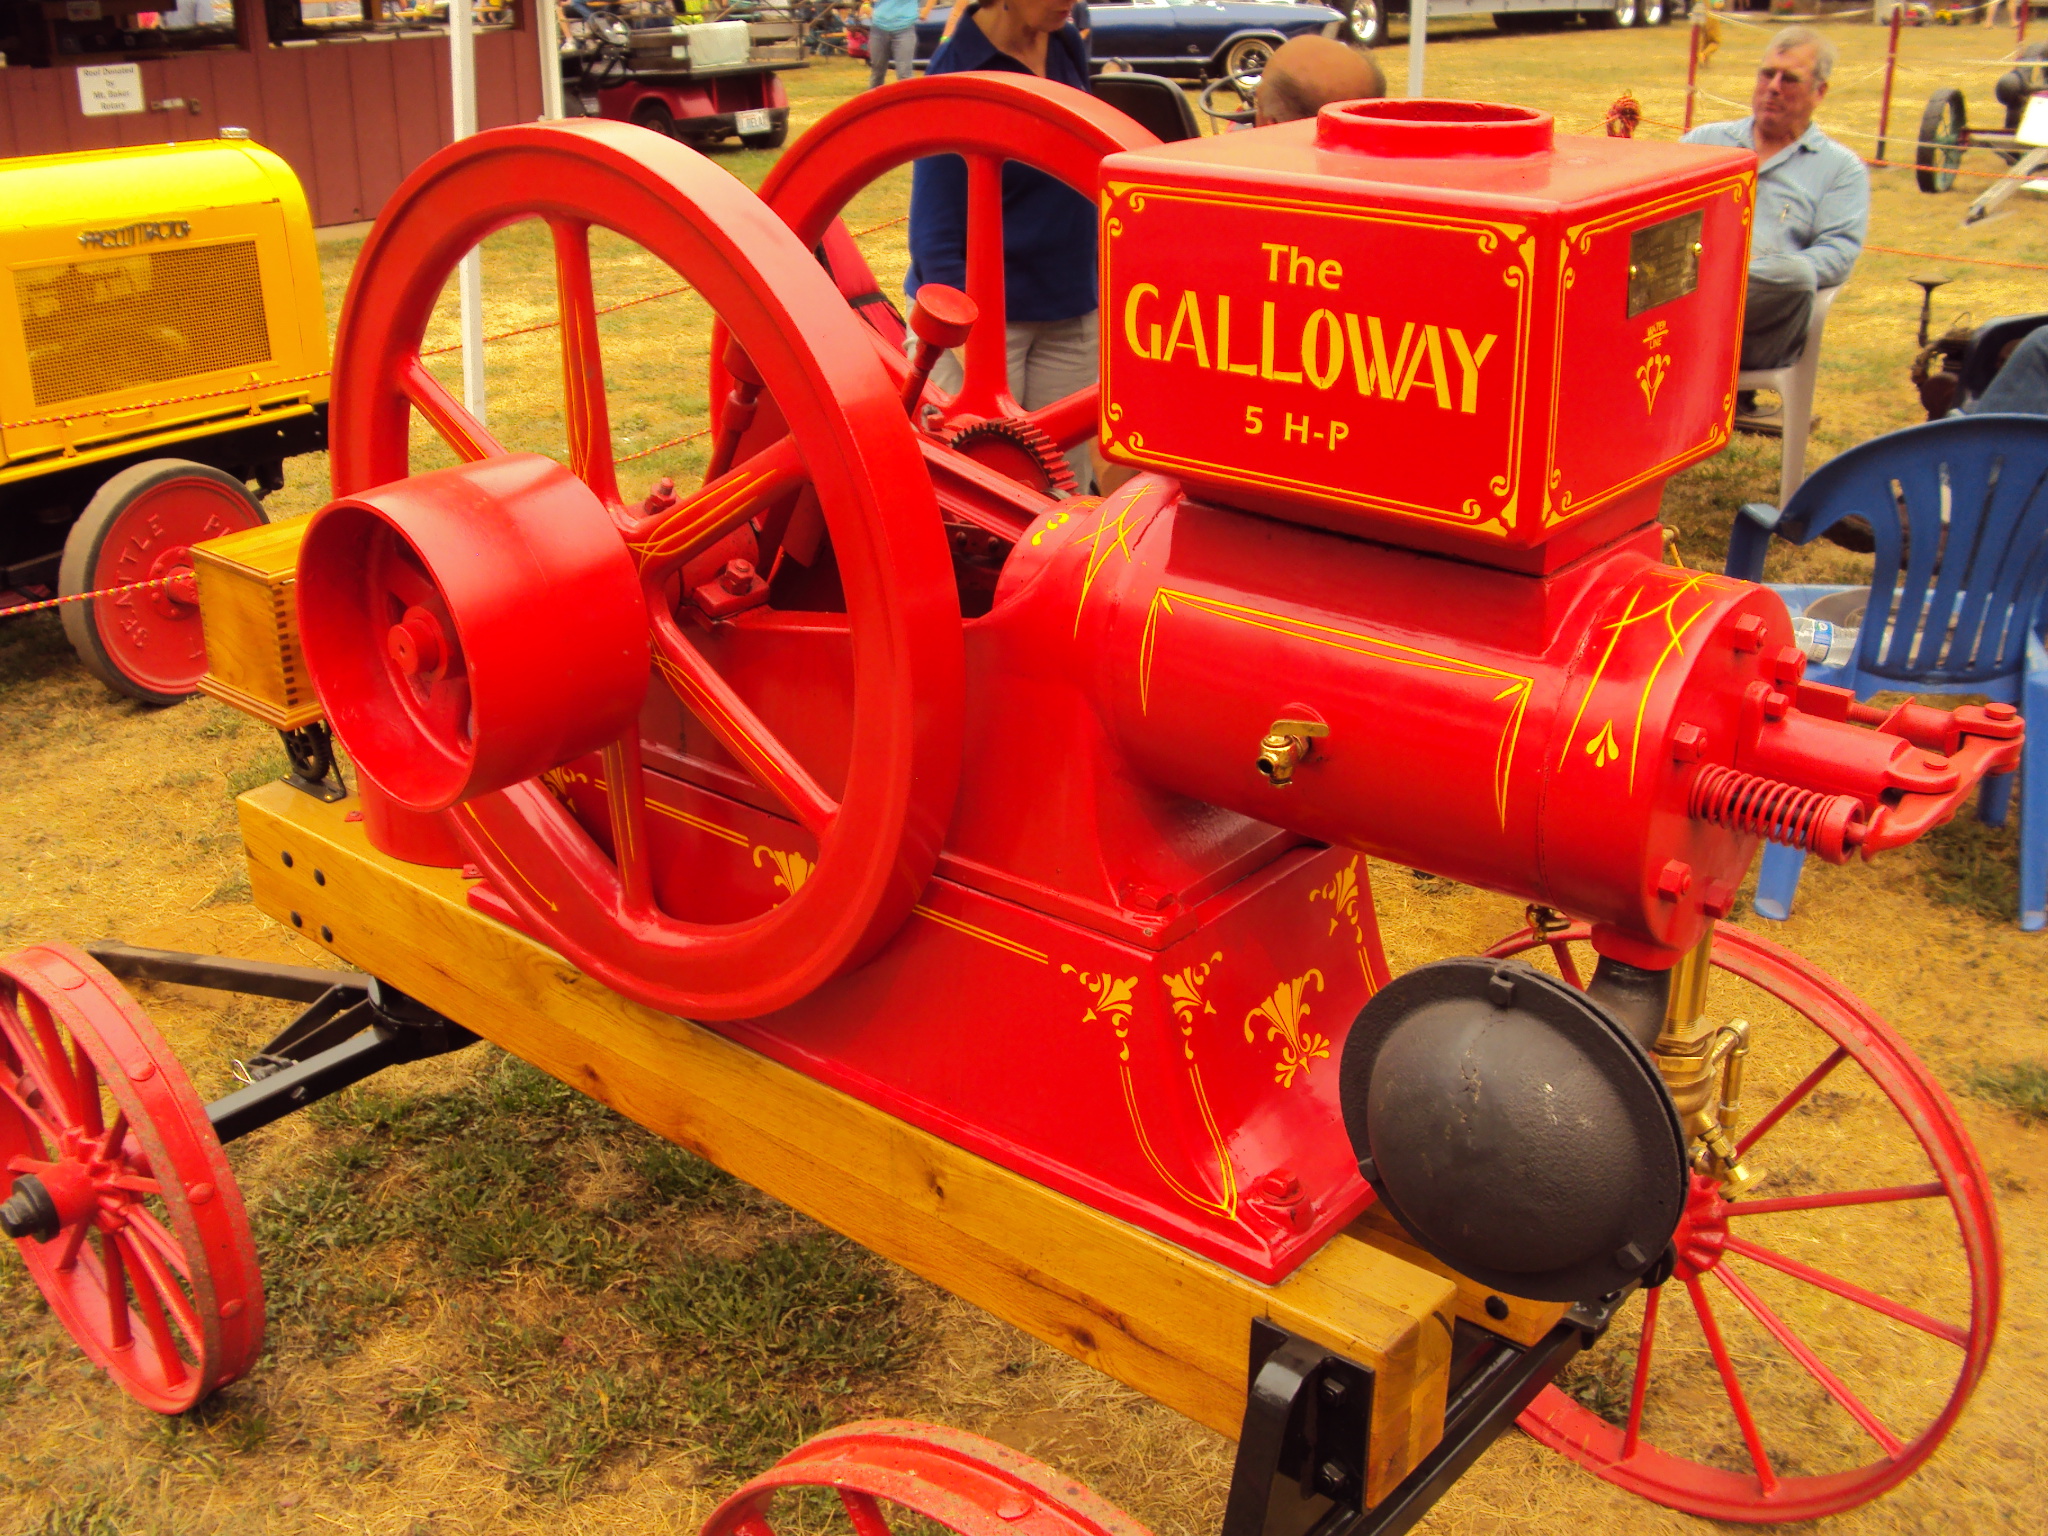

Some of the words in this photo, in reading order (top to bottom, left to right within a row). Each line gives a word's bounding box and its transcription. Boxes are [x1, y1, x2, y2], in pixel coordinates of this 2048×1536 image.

[103, 67, 134, 75] Donated
[105, 79, 115, 88] by
[108, 90, 130, 98] Baker
[101, 102, 125, 110] Rotary
[1261, 242, 1343, 290] The
[1647, 320, 1667, 337] WATER
[1124, 282, 1498, 414] GALLOWAY
[1649, 336, 1662, 349] LINE
[1245, 405, 1263, 434] 5
